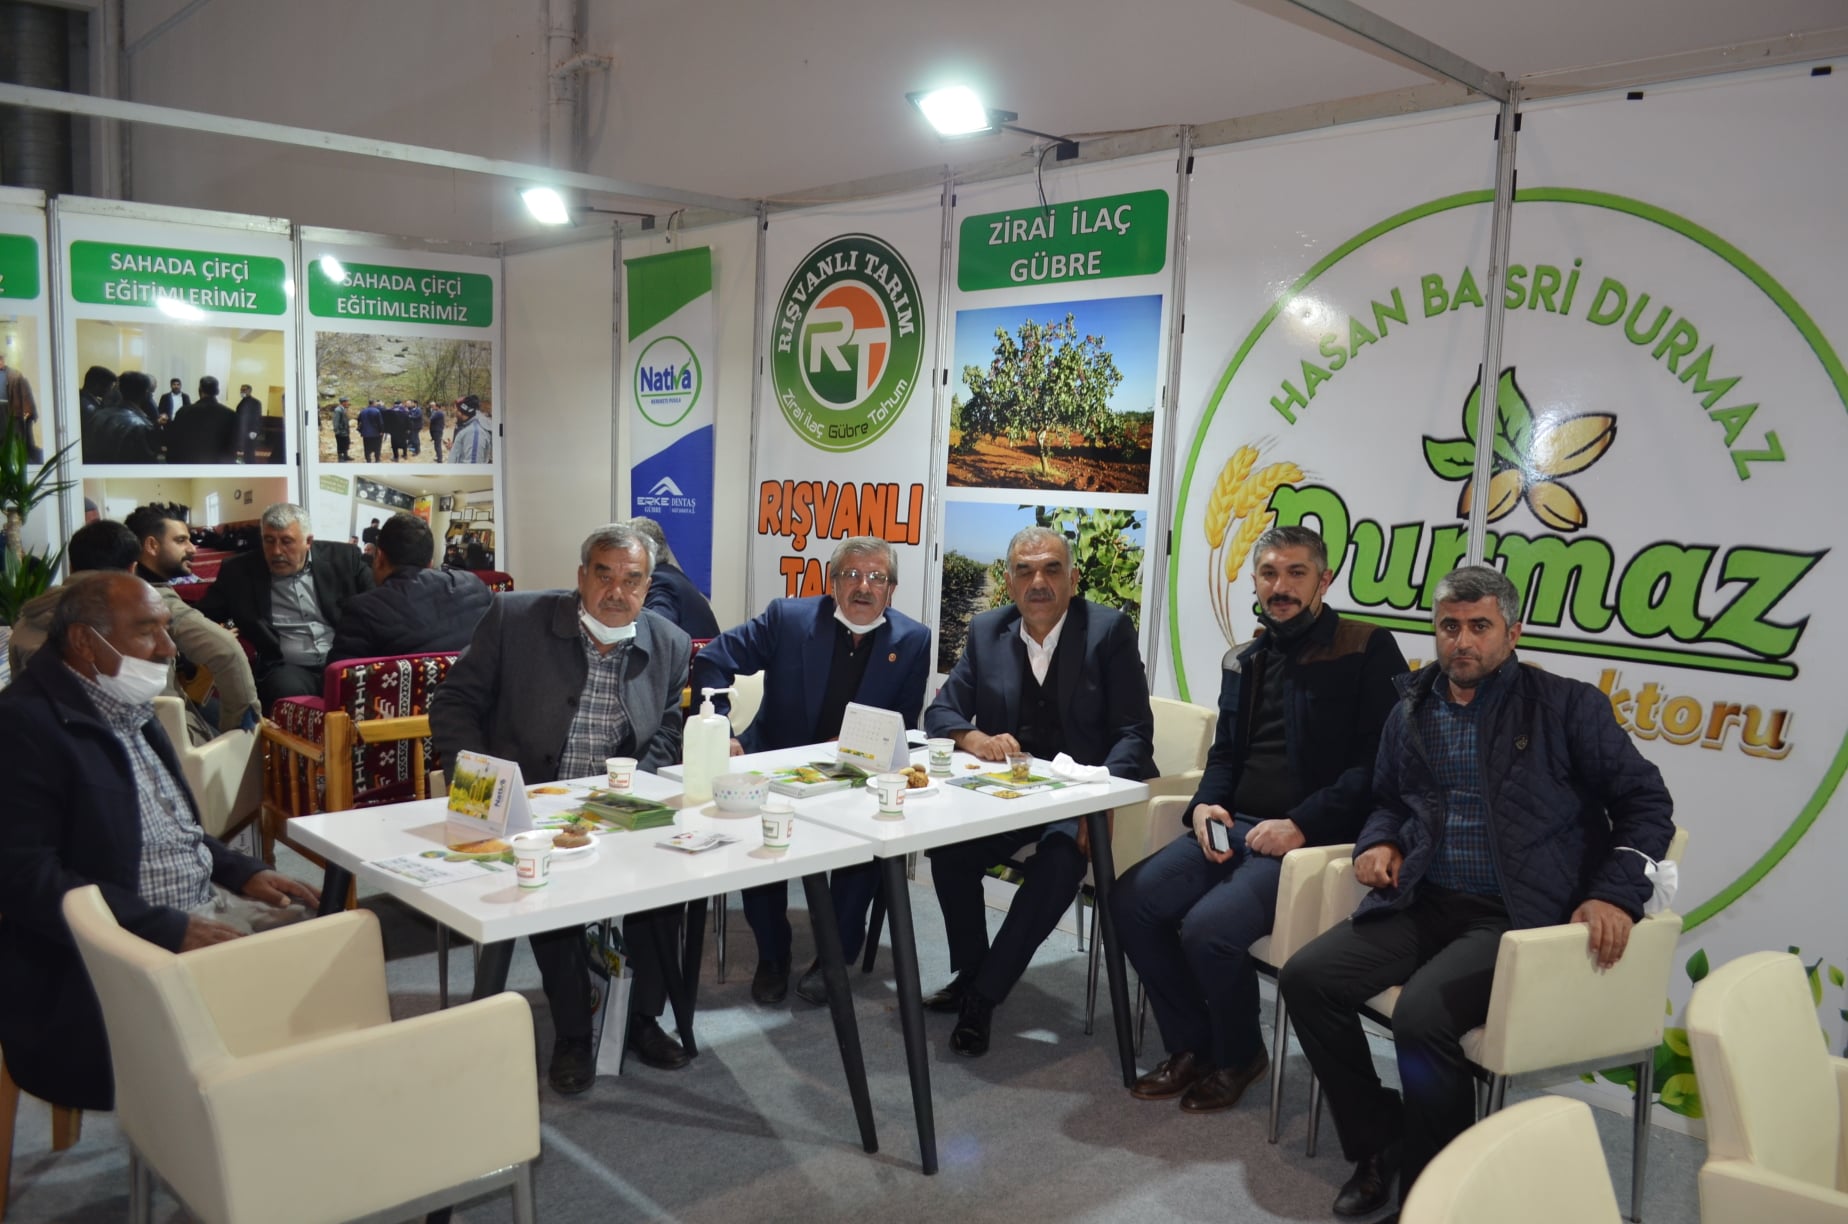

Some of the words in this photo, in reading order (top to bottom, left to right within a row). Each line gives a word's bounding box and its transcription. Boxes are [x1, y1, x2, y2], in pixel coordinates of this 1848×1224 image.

[988, 209, 1056, 246] ZİRAİ
[1071, 204, 1132, 236] İLAÇ
[111, 252, 197, 277] SAHADA
[202, 257, 249, 284] ÇİFÇİ
[343, 271, 417, 293] SAHADA
[421, 275, 462, 298] ÇİFÇİ
[1010, 250, 1102, 283] GÜBRE
[104, 278, 258, 310] EĞİTİMLERİMİZ
[337, 295, 468, 322] EĞİTİMLERİMİZ
[778, 250, 859, 354] RIŞVANLI
[863, 252, 915, 338] TARIM
[640, 358, 692, 393] Nativa
[1269, 286, 1409, 426] HASAN
[1586, 275, 1786, 482] DURMAZ
[828, 421, 869, 439] Gübre
[866, 378, 909, 426] Tohum
[636, 496, 670, 507] ERKE
[758, 479, 925, 552] RIŞVANLI
[1262, 483, 1832, 659] Durmaz
[1597, 667, 1794, 760] ktoru
